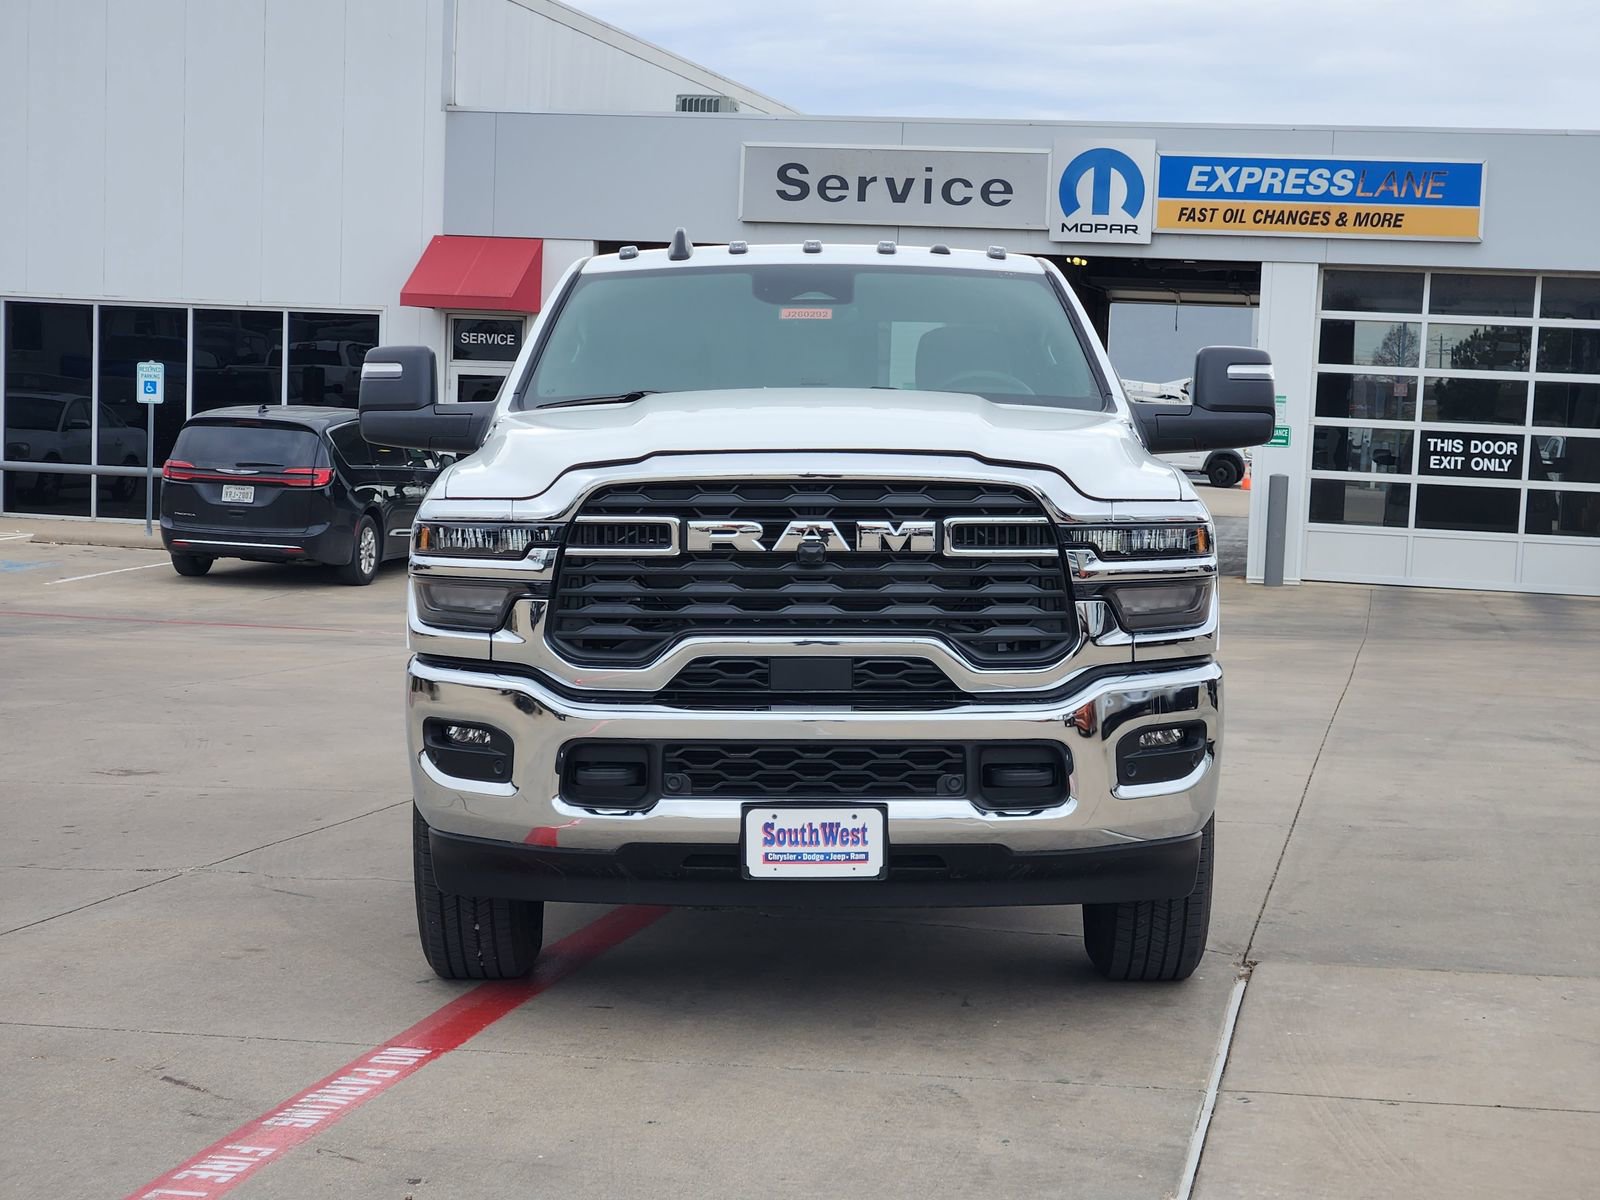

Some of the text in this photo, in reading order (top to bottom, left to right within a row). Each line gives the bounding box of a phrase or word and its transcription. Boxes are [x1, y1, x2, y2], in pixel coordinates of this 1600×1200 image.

[776, 162, 1014, 207] Service
[1177, 206, 1404, 228] FAST OIL CHANGES & MORE
[1061, 222, 1138, 234] MOPAR
[460, 332, 516, 345] SERVICE
[1427, 438, 1518, 455] THIS DOOR
[1429, 455, 1512, 472] EXIT ONLY
[687, 520, 936, 552] RAM
[762, 821, 869, 848] SouthWest
[768, 852, 866, 862] Chrysler Dodge Jeep Ram
[173, 1047, 433, 1184] NO PARKING FIRE
